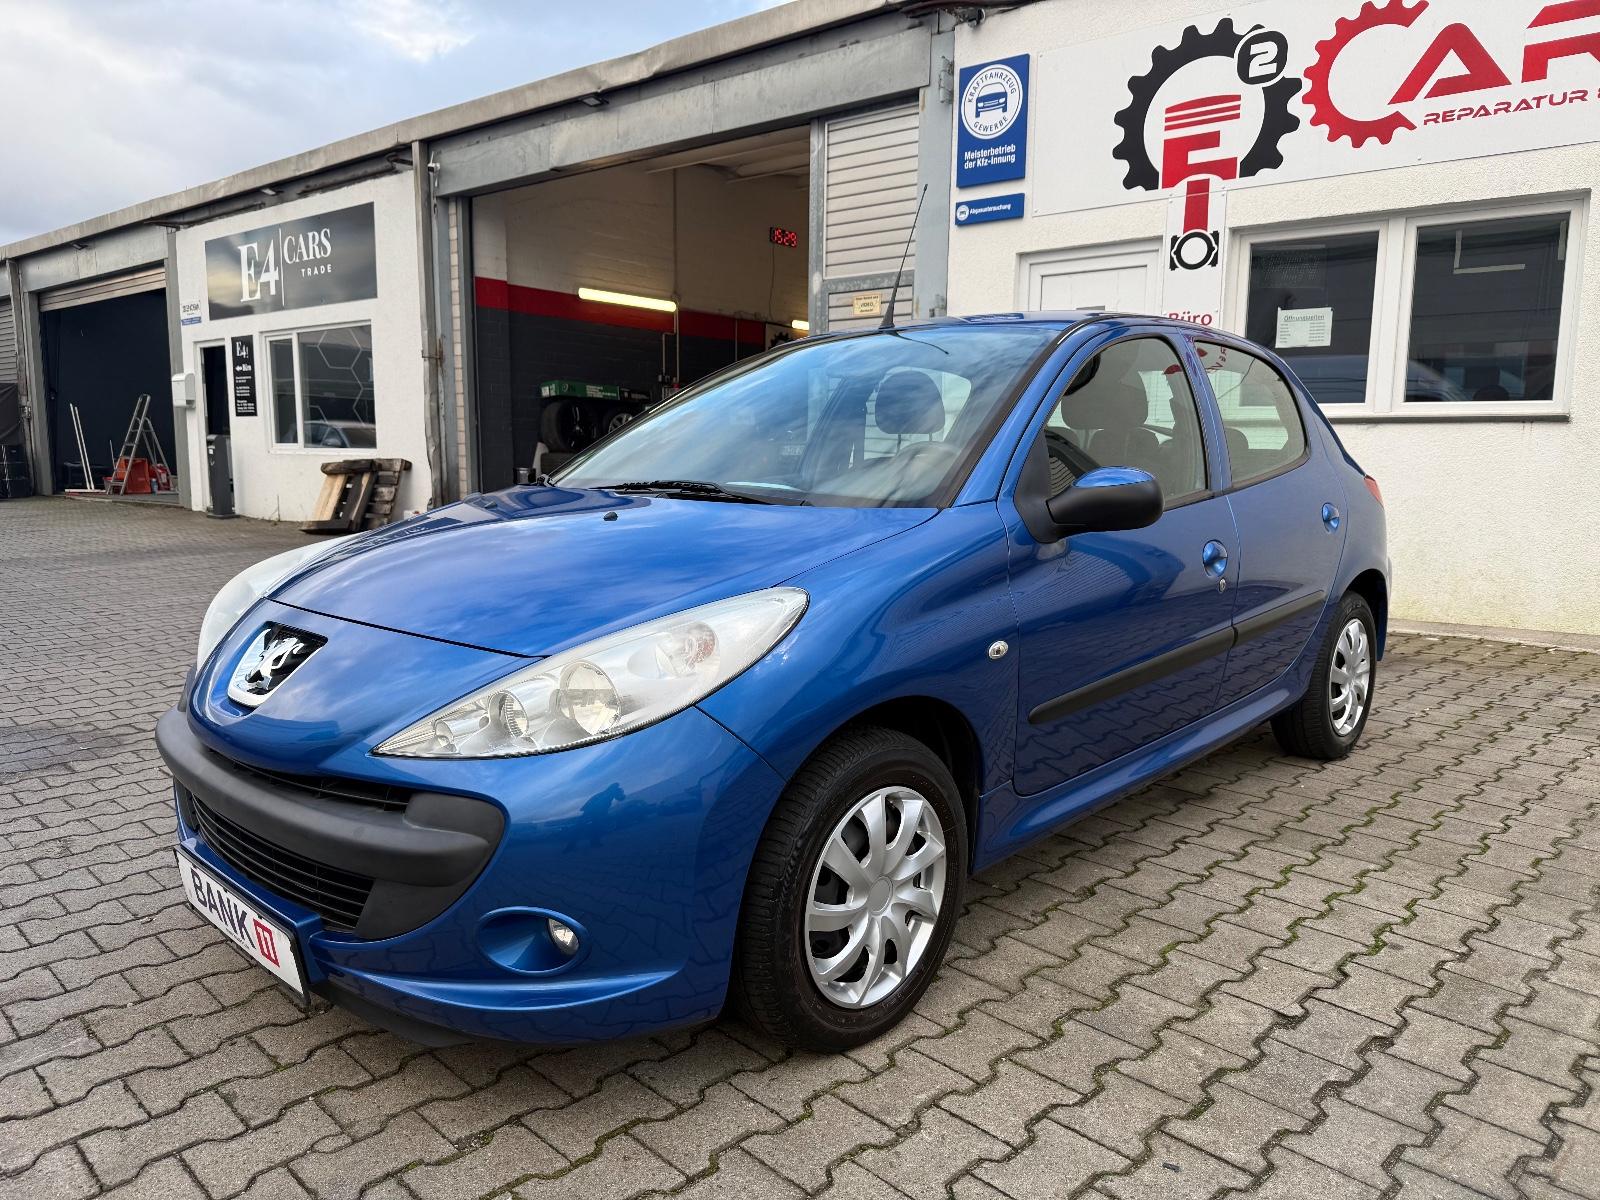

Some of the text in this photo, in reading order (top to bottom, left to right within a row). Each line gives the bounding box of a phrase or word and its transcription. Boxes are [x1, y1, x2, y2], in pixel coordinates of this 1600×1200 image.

[1249, 41, 1278, 78] 2
[968, 71, 1017, 103] KRAFTFAHRZEUG
[973, 115, 1009, 132] GEWERBE
[1424, 90, 1588, 126] REPARATUR
[964, 143, 1017, 161] Meisterbetrieb
[964, 153, 1016, 170] der Kfz-Innung
[237, 228, 332, 302] E4 CARS
[301, 264, 332, 277] TRADE
[191, 868, 257, 950] BANK
